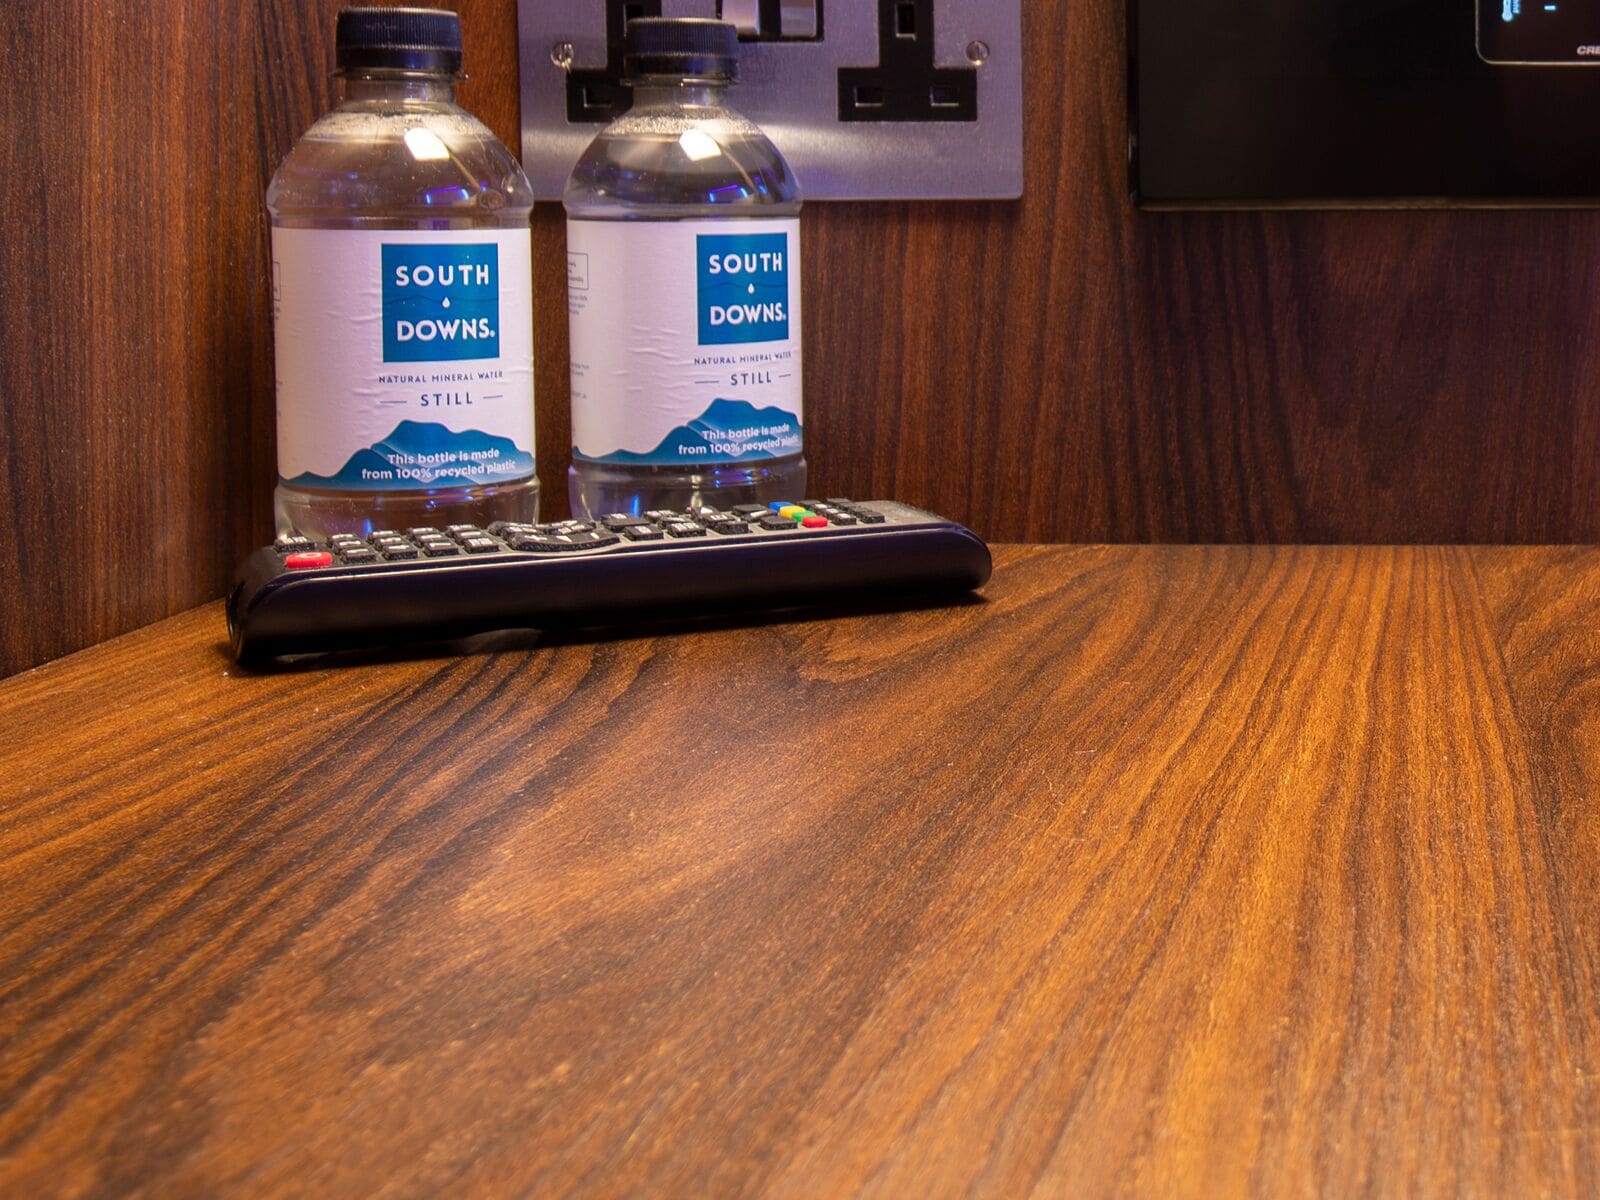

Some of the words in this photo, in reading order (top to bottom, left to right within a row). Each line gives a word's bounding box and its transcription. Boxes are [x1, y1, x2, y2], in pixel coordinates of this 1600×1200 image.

[709, 253, 782, 274] SOUTH
[395, 265, 489, 286] SOUTH
[694, 357, 736, 365] NATURAL
[740, 354, 772, 362] MINERAL
[775, 351, 791, 359] WATER
[379, 375, 426, 383] NATURAL
[432, 373, 473, 382] MINERAL
[478, 371, 503, 379] WATER
[731, 372, 771, 386] STILL
[421, 392, 472, 407] STILL
[702, 429, 725, 440] This
[728, 427, 759, 438] bottle
[762, 425, 769, 434] is
[770, 423, 789, 434] made
[679, 445, 706, 454] from
[709, 442, 740, 453] 100%
[742, 439, 780, 451] recycled
[388, 453, 414, 465] This
[418, 452, 457, 464] bottle
[460, 450, 469, 460] is
[471, 448, 500, 460] made
[362, 468, 393, 479] from
[396, 468, 431, 479] 100%
[435, 464, 484, 478] recycled
[486, 459, 516, 473] plastic
